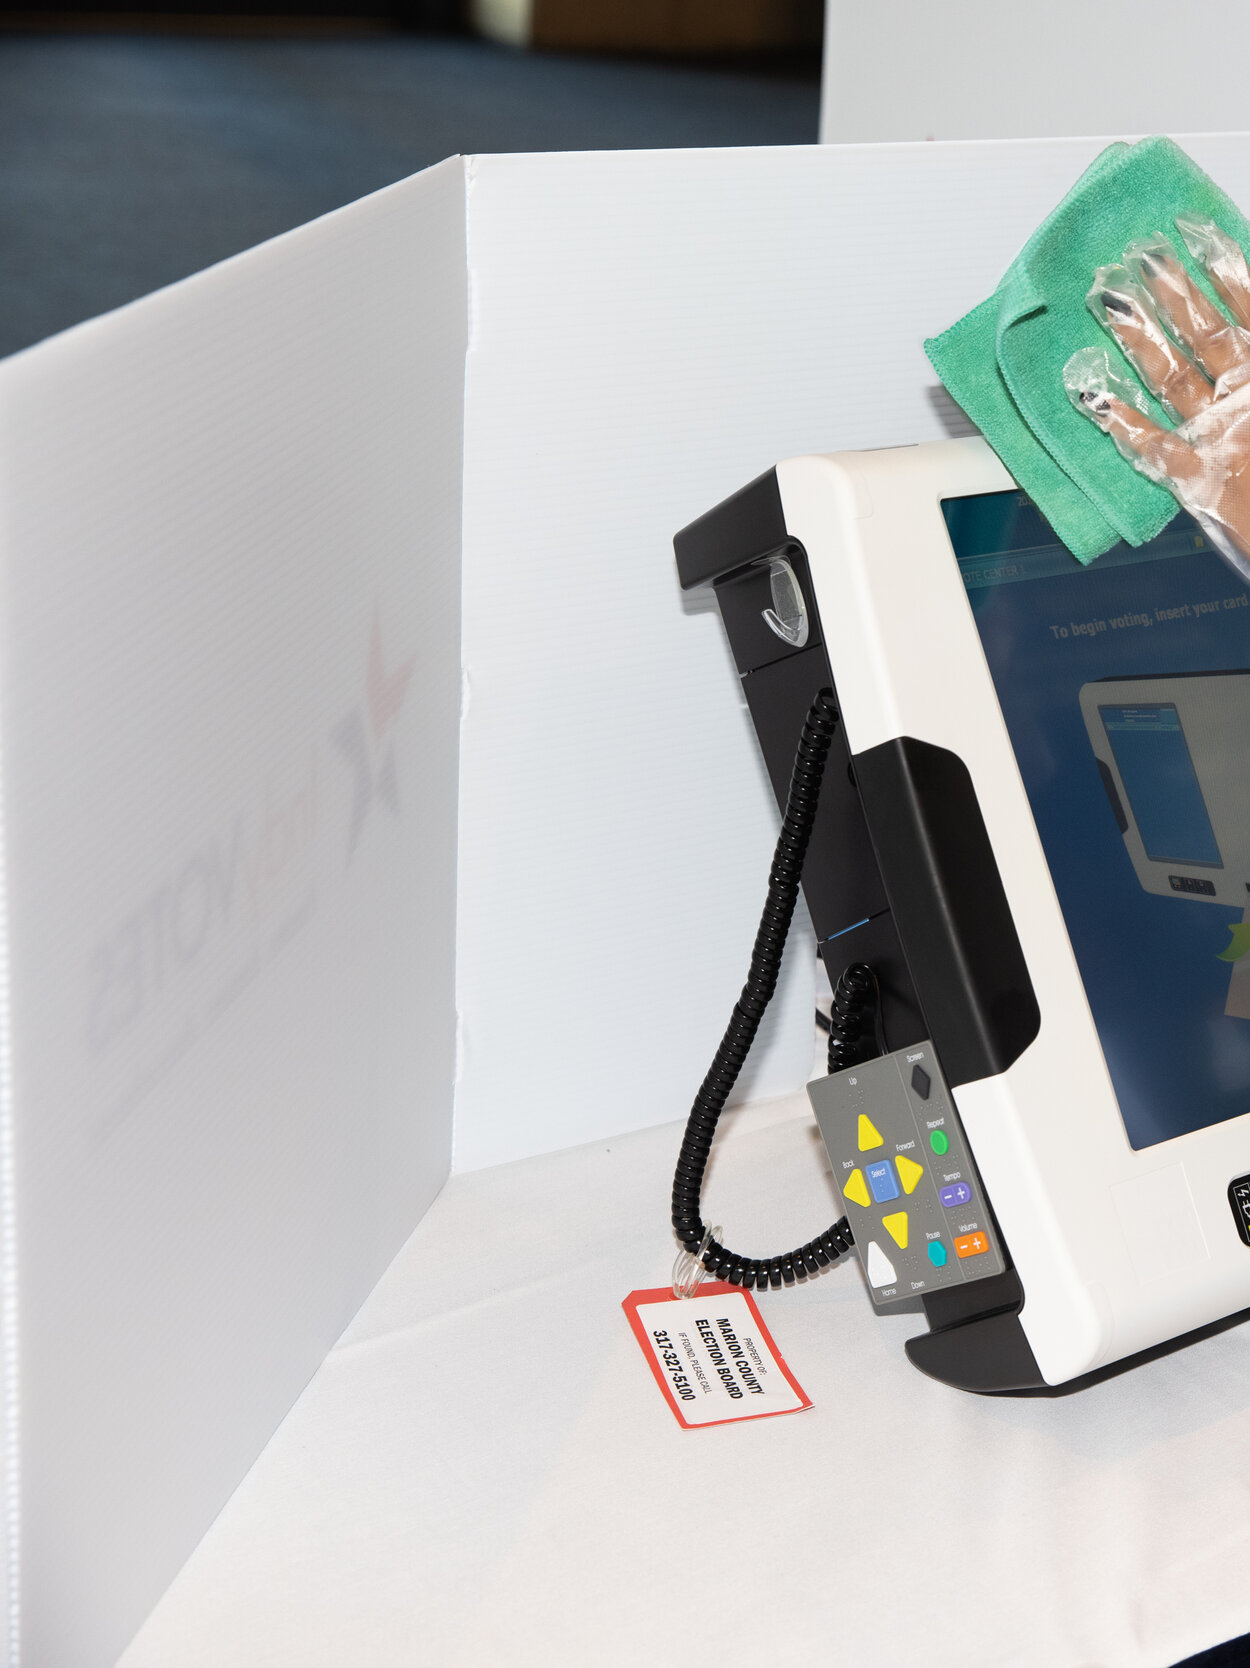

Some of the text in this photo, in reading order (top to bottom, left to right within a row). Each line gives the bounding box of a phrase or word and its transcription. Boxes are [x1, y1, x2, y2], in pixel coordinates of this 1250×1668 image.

[962, 570, 982, 584] OTE
[1050, 624, 1069, 640] To
[1070, 618, 1107, 637] begin
[1109, 612, 1153, 628] voting,
[1154, 604, 1192, 622] insert
[1192, 599, 1220, 618] your
[906, 1052, 925, 1063] Screen
[848, 1077, 858, 1086] Up
[926, 1118, 945, 1129] Repeat
[896, 1140, 915, 1152] Forward
[842, 1159, 855, 1169] Back
[871, 1168, 886, 1178] Select
[943, 1171, 961, 1182] Tempo
[958, 1222, 978, 1233] Volume
[925, 1231, 941, 1241] Pause
[911, 1280, 925, 1290] Down
[881, 1287, 897, 1297] Home
[715, 1318, 765, 1395] MARION COUNTY
[743, 1337, 763, 1366] PROPERTY
[695, 1319, 744, 1400] ELECTION BOARD
[653, 1330, 696, 1401] 317-327-5100
[690, 1360, 706, 1381] PLEASE
[700, 1381, 712, 1394] CALL
